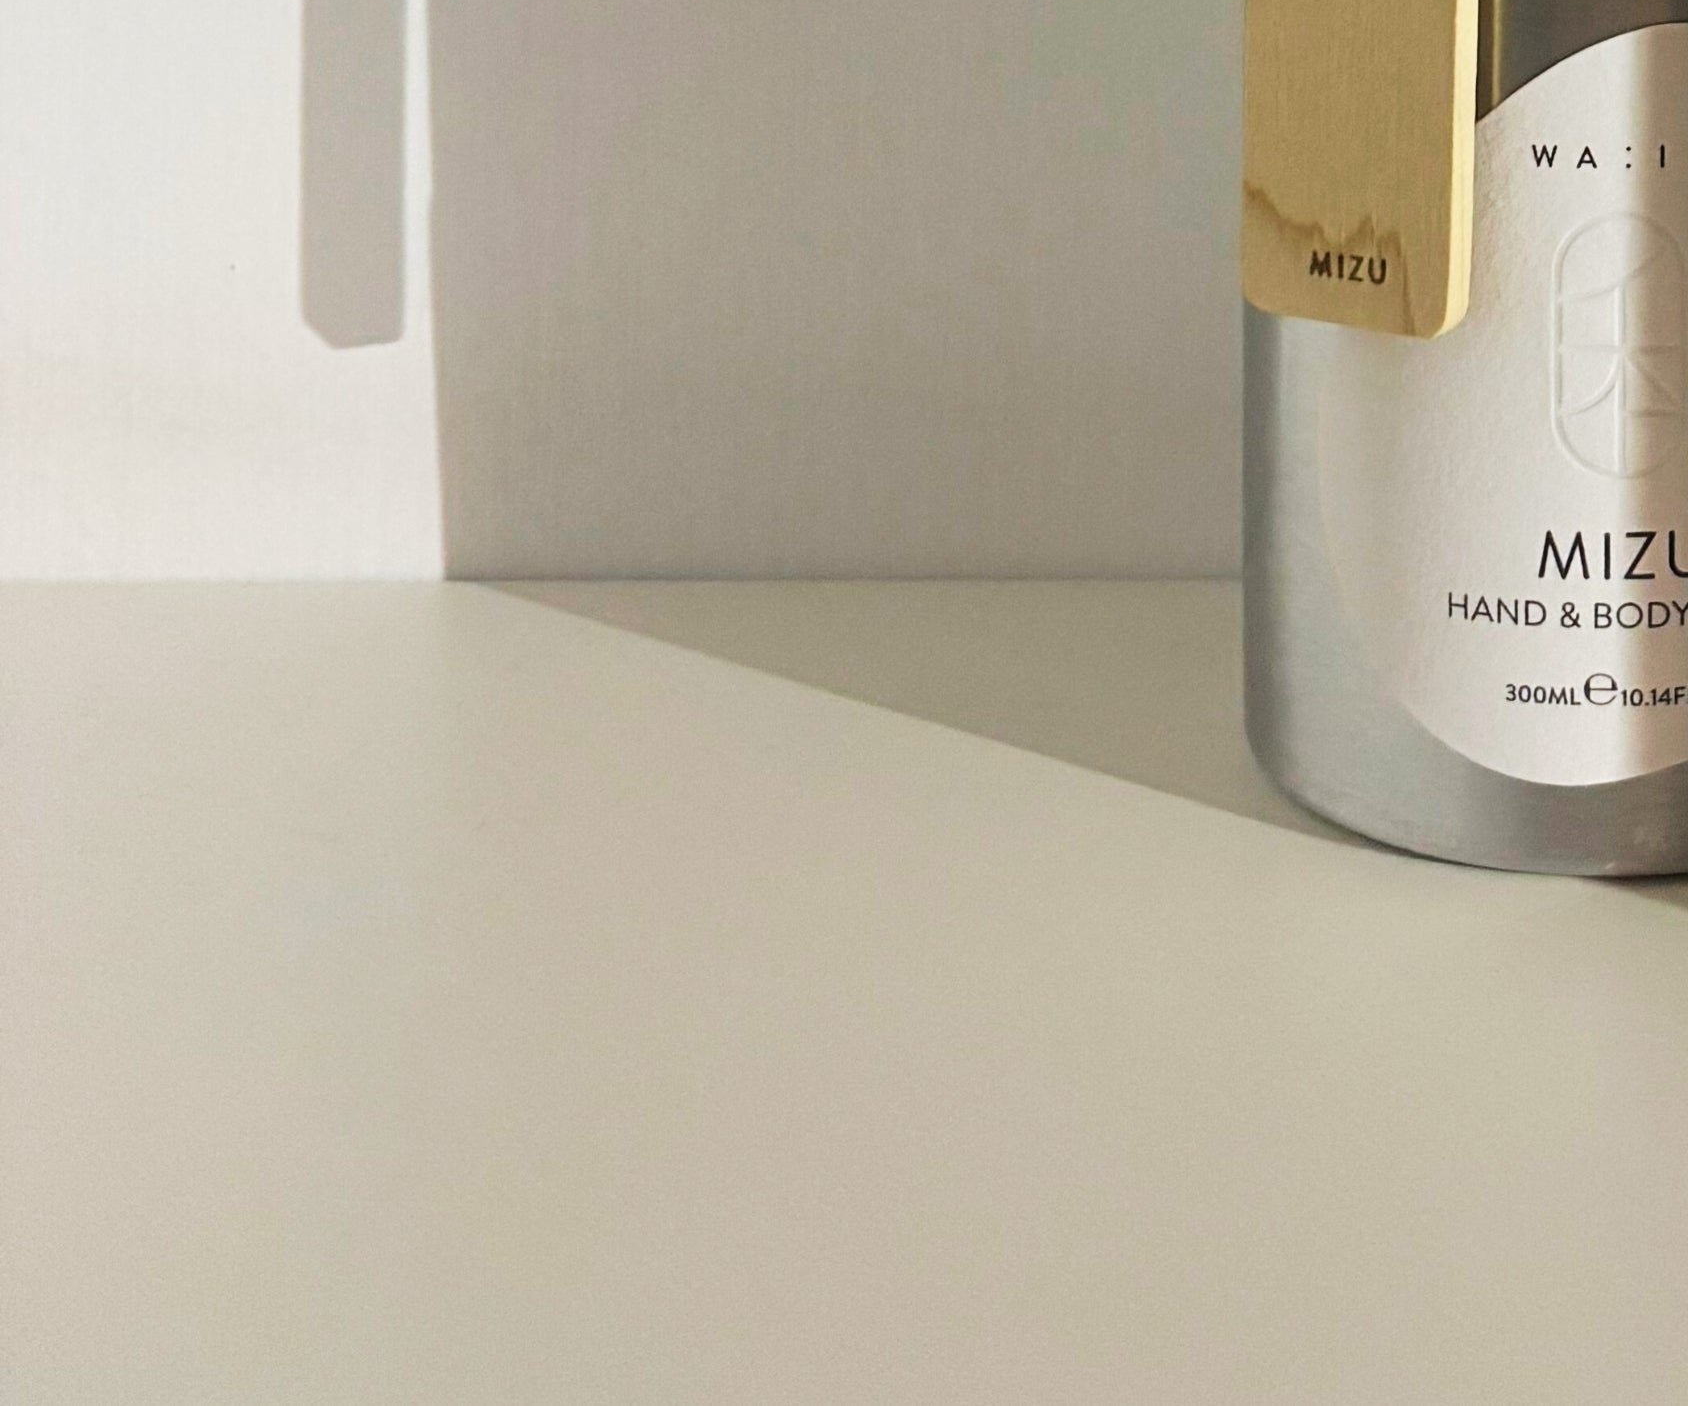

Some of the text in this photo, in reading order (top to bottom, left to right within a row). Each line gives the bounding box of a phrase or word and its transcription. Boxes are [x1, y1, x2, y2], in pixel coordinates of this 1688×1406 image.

[1309, 250, 1387, 285] MIZU
[1447, 592, 1547, 627] HAND
[1560, 602, 1582, 629] &
